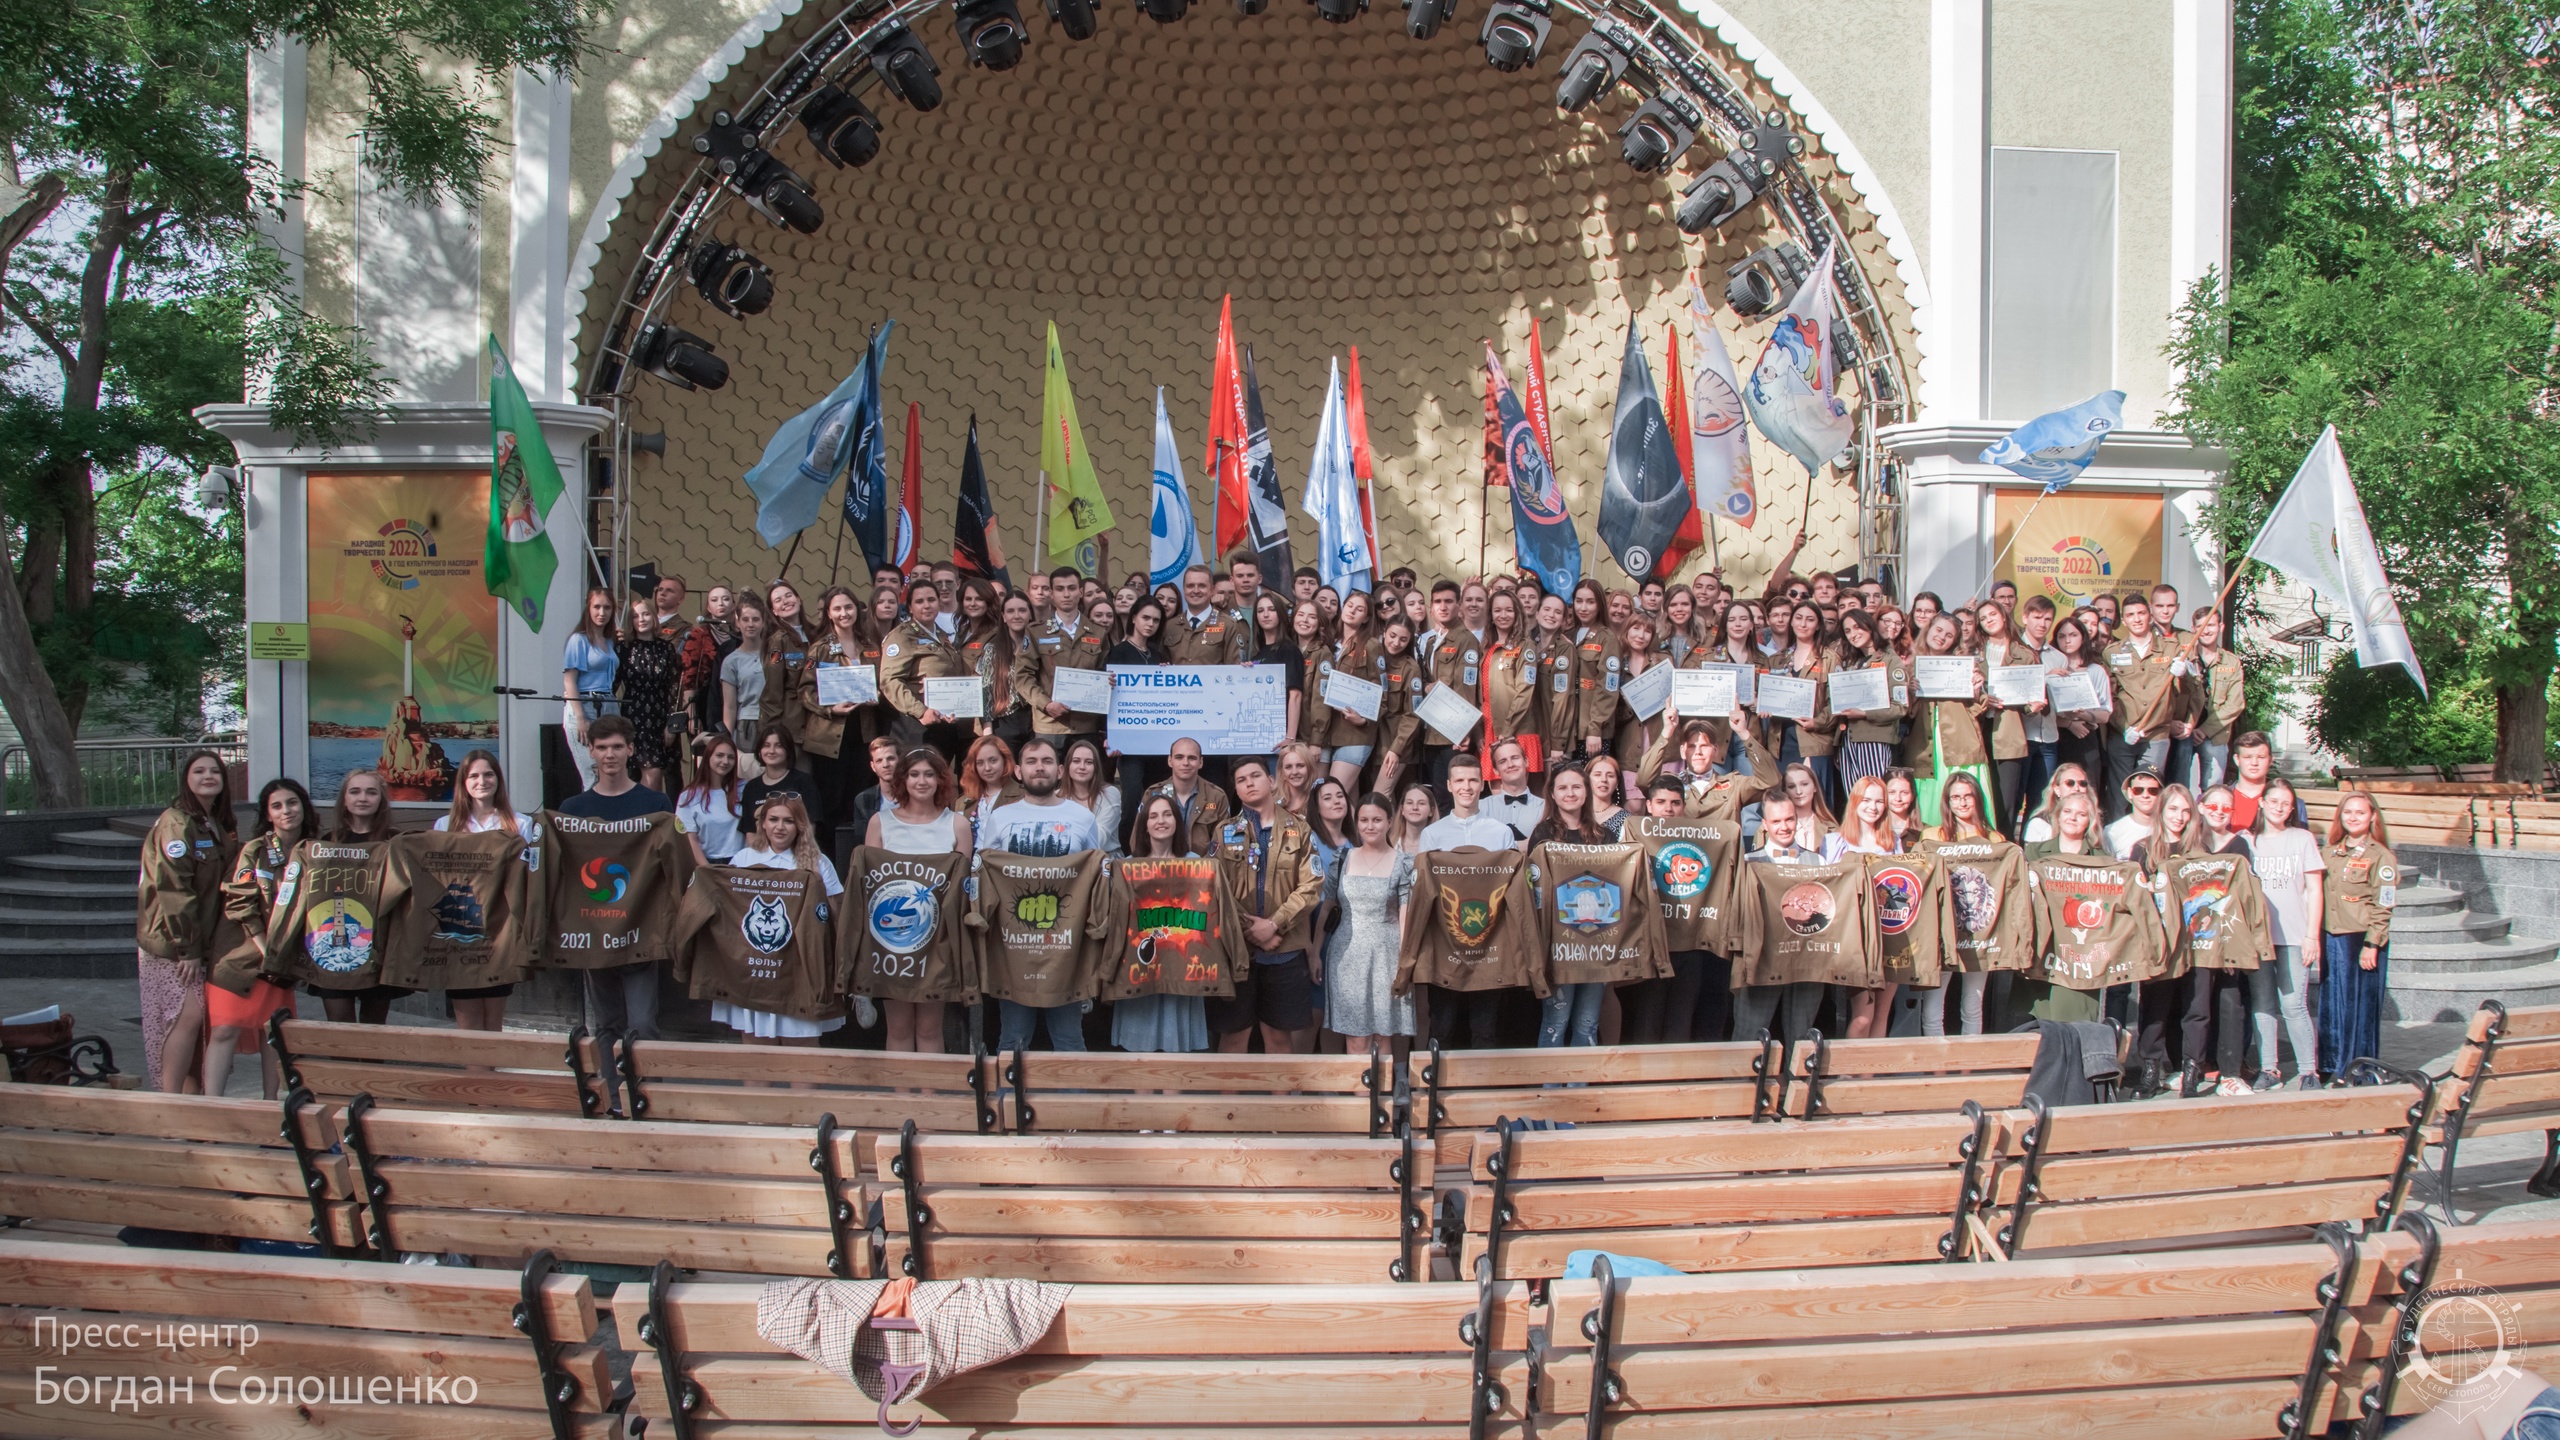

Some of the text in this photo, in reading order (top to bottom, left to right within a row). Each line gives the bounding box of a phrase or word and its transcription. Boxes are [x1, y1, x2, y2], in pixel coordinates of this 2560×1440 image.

[344, 549, 386, 557] ТВОРЧЕСТВО
[350, 540, 419, 556] НАРОДНОЕ 2022
[406, 560, 446, 568] КУЛЬТУРНОГО
[2017, 565, 2059, 574] ТВОРЧЕСТВО
[2024, 556, 2092, 574] НАРОДНОЕ 2022
[2080, 578, 2119, 586] КУЛЬТУРНОГО
[1117, 671, 1203, 687] ПУТЁВКА
[1118, 717, 1181, 725] МООО «РСО»
[554, 816, 652, 834] СЕВАСТОПОЛЬ
[1641, 816, 1721, 840] Севастополь
[1002, 865, 1079, 879] СЕВАСТОПОЛЬ
[1122, 859, 1216, 881] СЕВАСТОПОЛЬ
[1432, 865, 1515, 875] СЕВАСТОПОЛЬ
[730, 876, 804, 889] СЕВАСТОПОЛЬ
[1137, 906, 1208, 932] КИПИШ
[1699, 907, 1719, 920] 2021
[560, 932, 592, 949] 2021
[1778, 940, 1801, 953] 2021
[1589, 944, 1616, 961] МГУ
[1618, 947, 1640, 959] 2021
[748, 957, 783, 967] ВОЛЬТ
[872, 952, 928, 977] 2021
[751, 969, 777, 979] 2021
